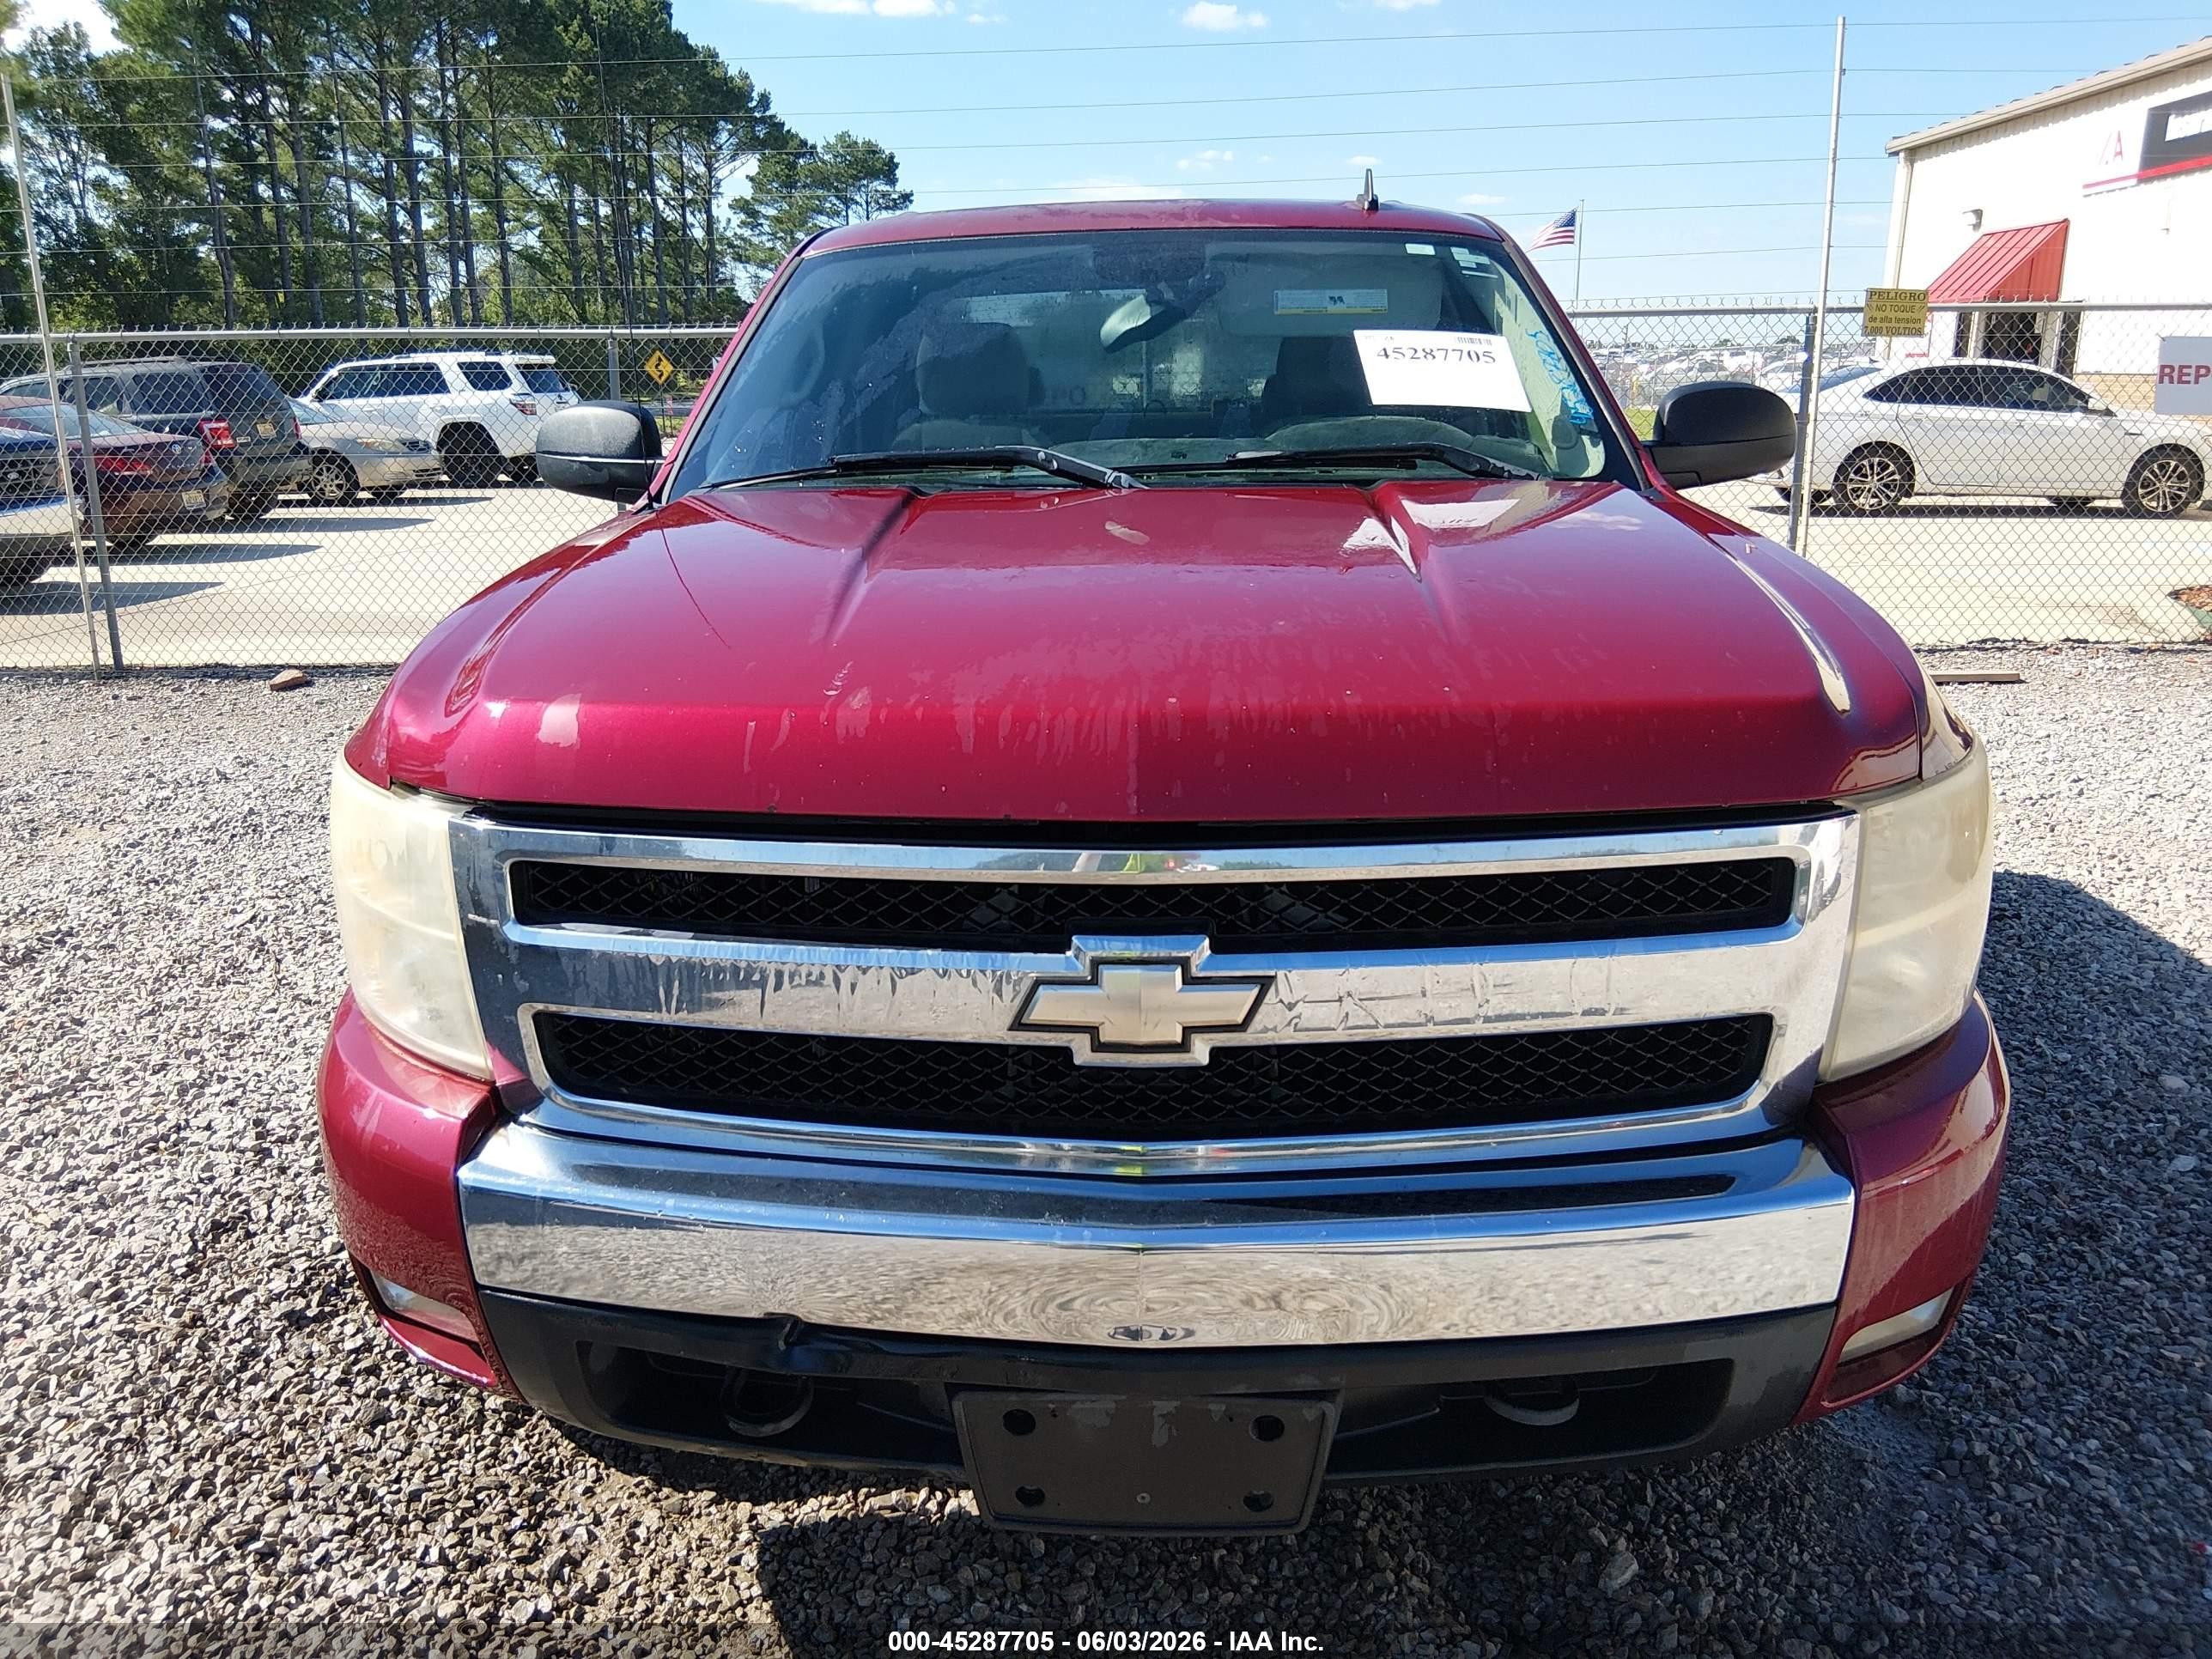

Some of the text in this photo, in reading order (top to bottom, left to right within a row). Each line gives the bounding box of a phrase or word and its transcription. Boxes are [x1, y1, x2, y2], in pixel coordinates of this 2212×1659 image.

[1869, 290, 1926, 301] PELIGRO
[1875, 304, 1917, 313] NO TOQUE
[1376, 347, 1496, 364] 45287705
[2158, 364, 2212, 385] REP
